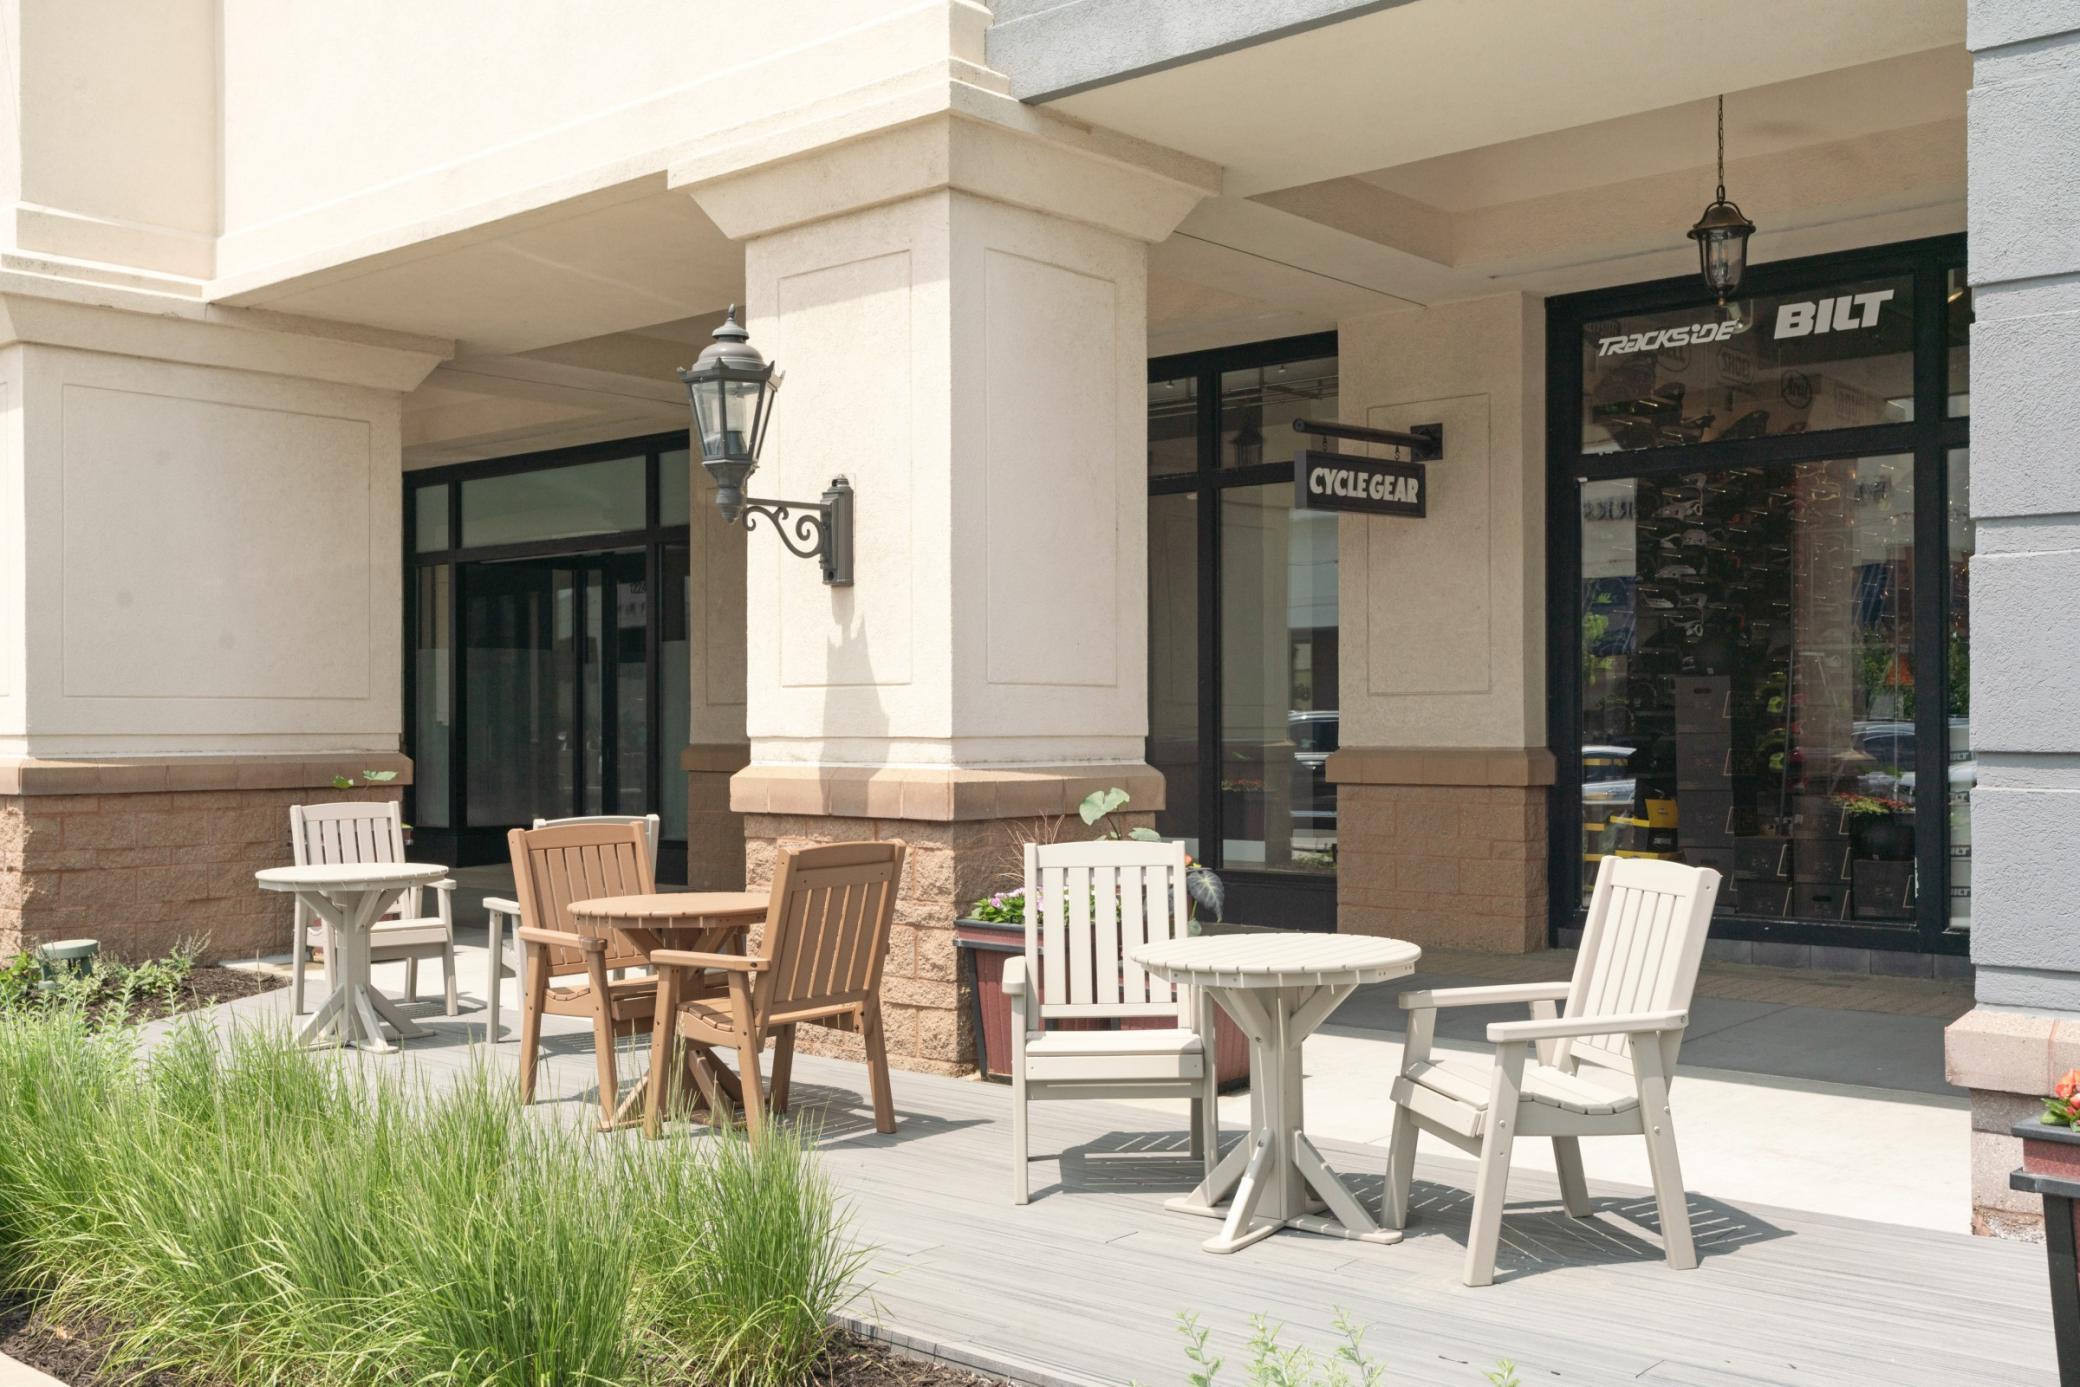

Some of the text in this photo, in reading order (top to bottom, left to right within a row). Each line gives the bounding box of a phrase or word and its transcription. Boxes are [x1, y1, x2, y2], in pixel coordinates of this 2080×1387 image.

[1774, 289, 1895, 340] BILT
[1309, 467, 1419, 504] CYCLE GEAR
